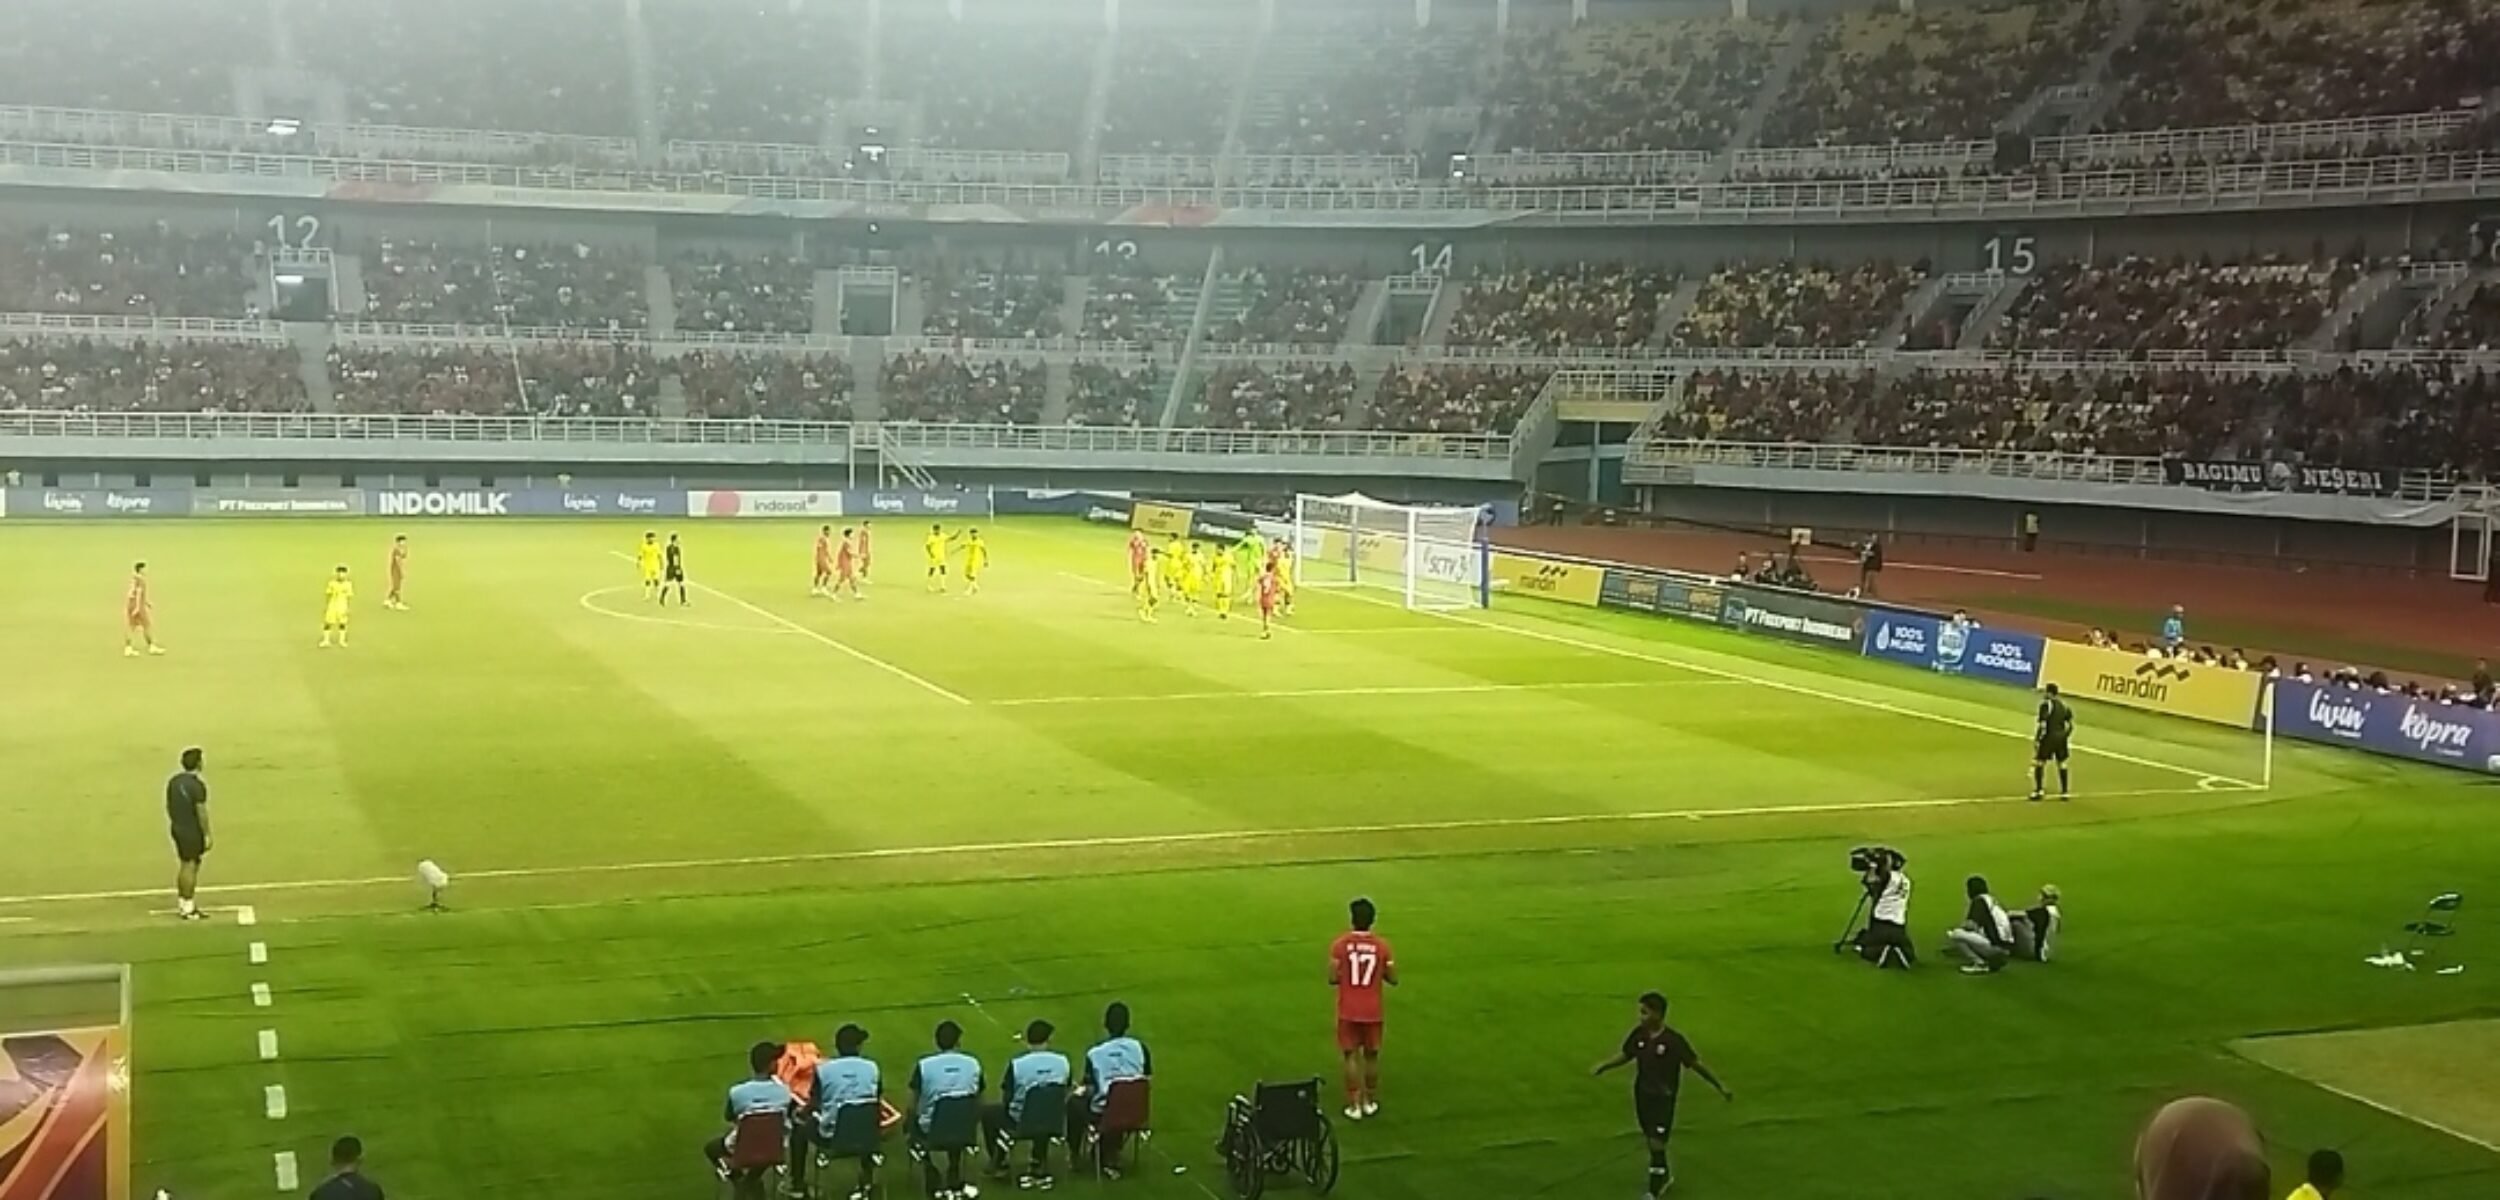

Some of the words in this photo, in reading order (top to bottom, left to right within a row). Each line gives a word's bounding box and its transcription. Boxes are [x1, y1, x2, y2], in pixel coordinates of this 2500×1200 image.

[268, 215, 318, 250] 12
[1411, 244, 1452, 277] 14
[1984, 238, 2034, 274] 15
[2182, 463, 2263, 483] BAGIMU
[379, 491, 509, 515] INDOMILK
[1974, 652, 2033, 673] INDONESIA
[1990, 642, 2023, 658] 100%
[2096, 672, 2168, 702] mandiri
[1349, 952, 1376, 985] 17
